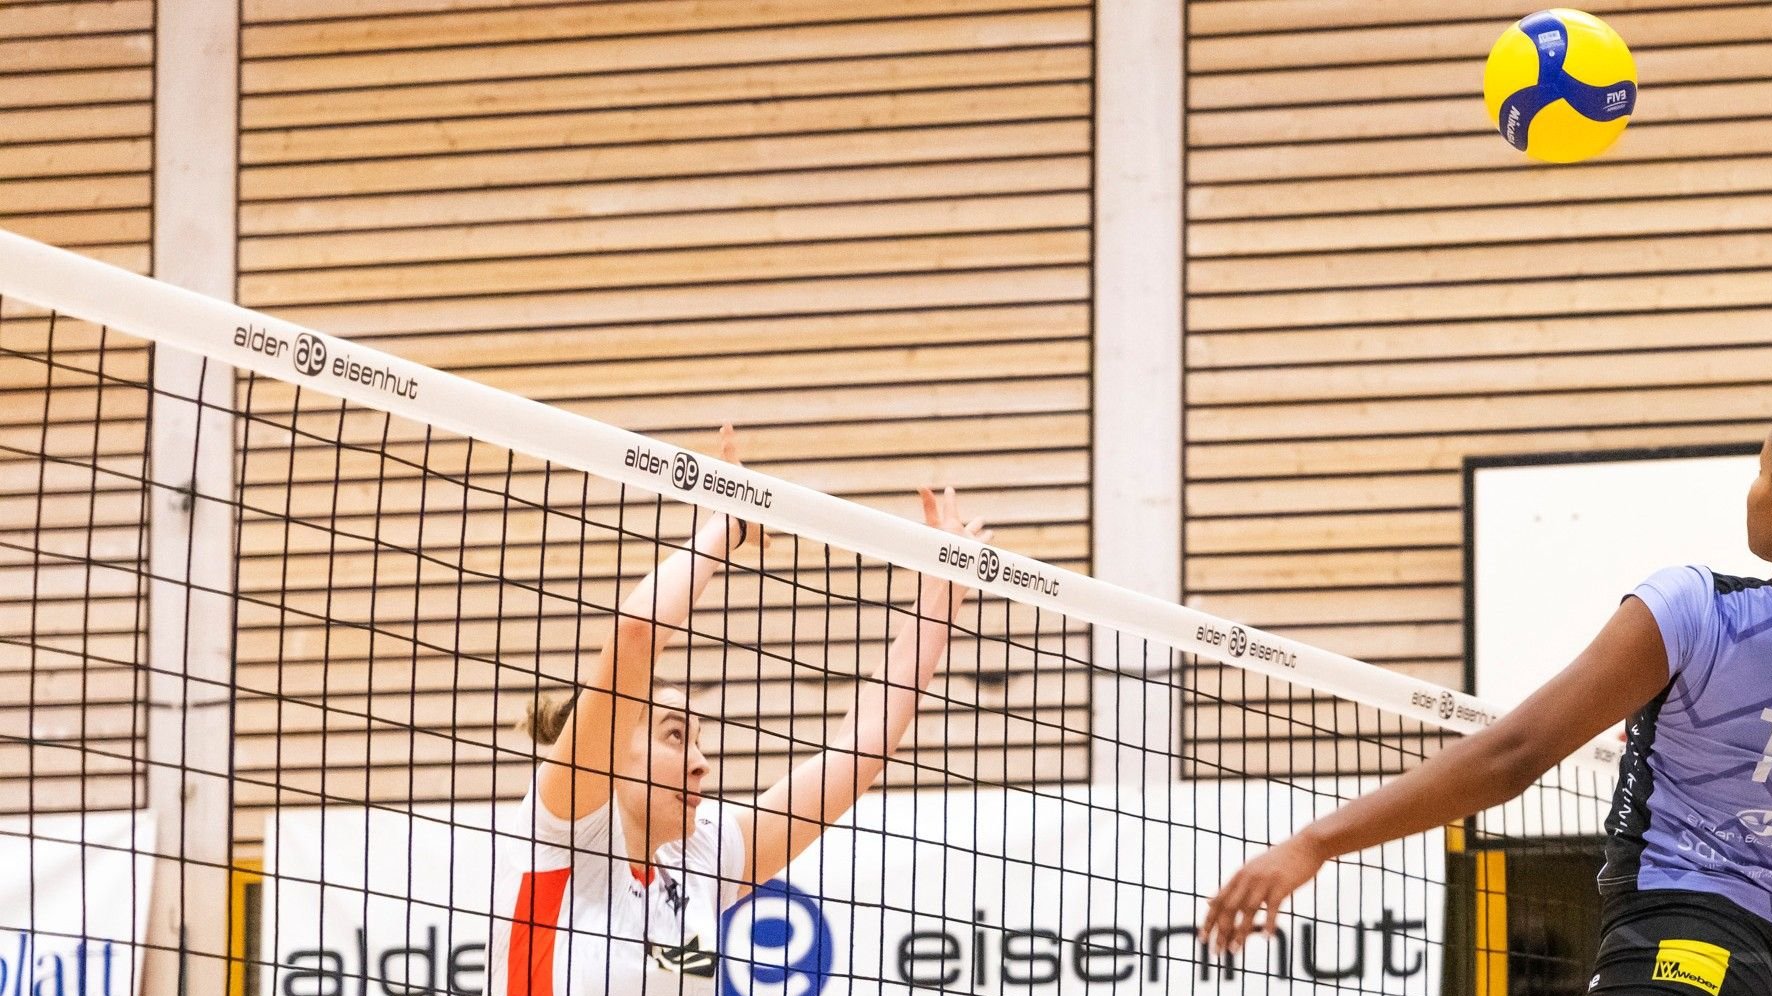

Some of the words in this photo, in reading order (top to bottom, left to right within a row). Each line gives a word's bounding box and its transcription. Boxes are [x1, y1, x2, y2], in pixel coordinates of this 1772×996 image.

[1607, 89, 1627, 104] FIVB
[234, 324, 289, 358] alder
[332, 354, 419, 400] eisenhut
[625, 446, 669, 476] alder
[703, 470, 773, 509] eisenhut
[939, 543, 975, 570] alder
[1002, 563, 1060, 597] eisenhut
[1196, 623, 1227, 647] alder
[1249, 640, 1297, 669] eisenhut
[1675, 969, 1719, 991] Weber
